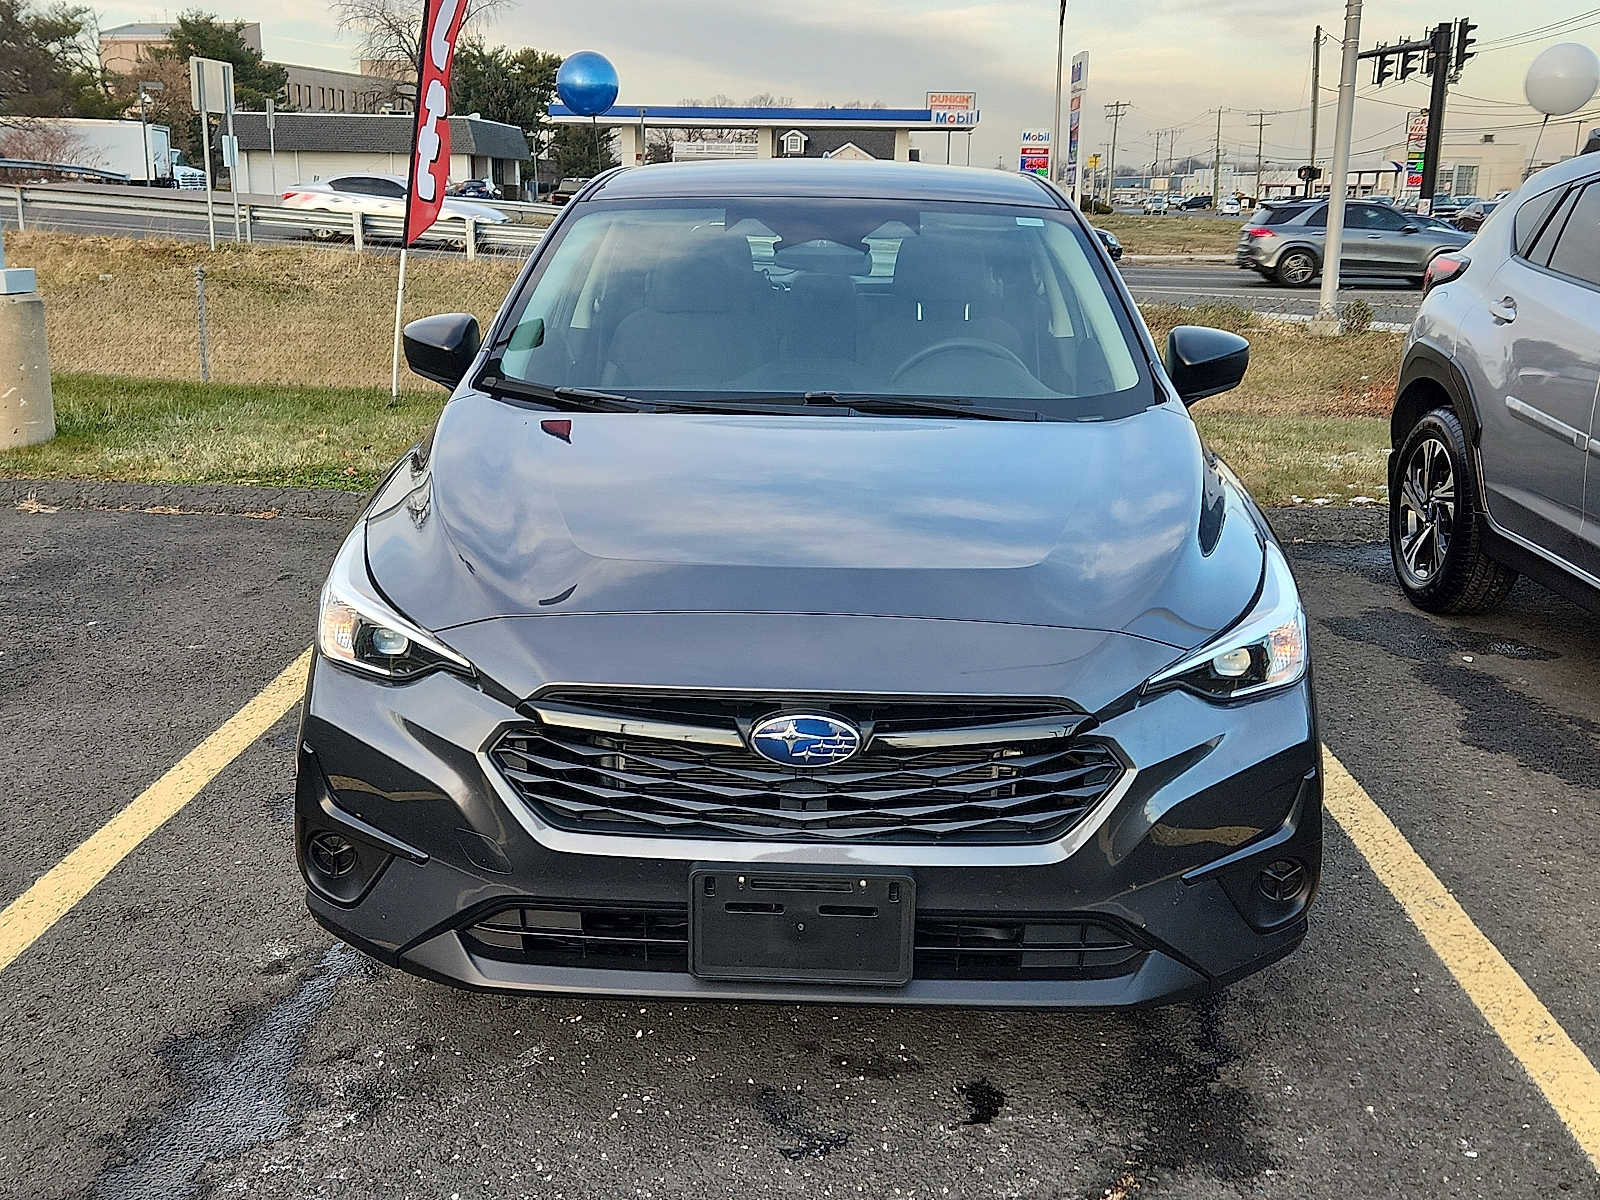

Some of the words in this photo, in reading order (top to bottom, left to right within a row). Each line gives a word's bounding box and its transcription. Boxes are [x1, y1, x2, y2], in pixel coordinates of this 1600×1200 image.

[930, 95, 972, 103] DUNKIN'
[935, 111, 973, 124] Mobil
[1022, 132, 1050, 141] Mobil
